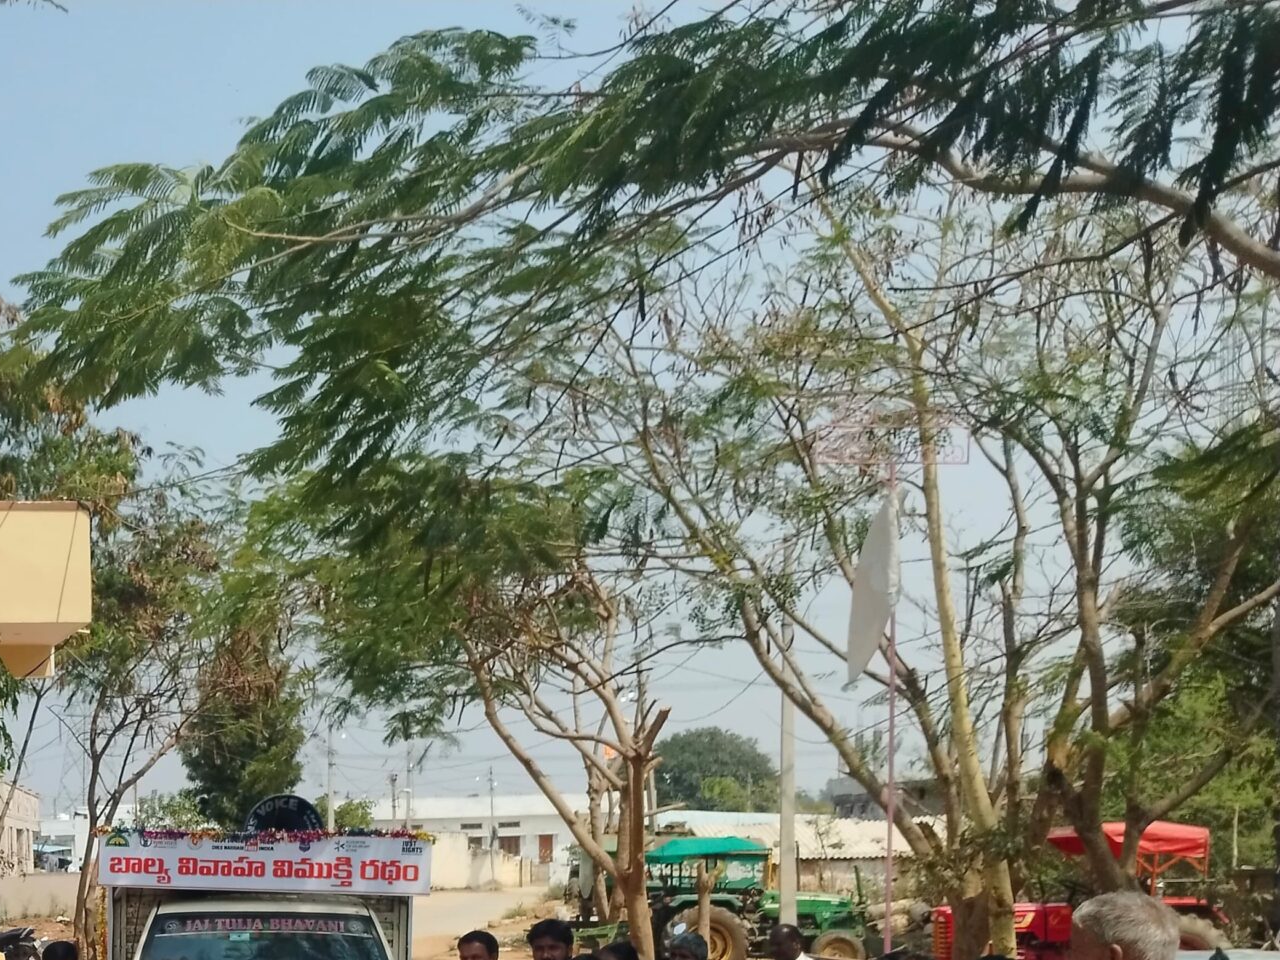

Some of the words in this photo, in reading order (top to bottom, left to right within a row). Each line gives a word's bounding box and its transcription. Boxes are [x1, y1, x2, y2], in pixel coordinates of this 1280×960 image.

[256, 798, 298, 816] VOICE
[109, 856, 172, 884] బాల్య
[178, 856, 266, 878] వివాహ
[272, 856, 352, 888] విముక్తి
[360, 859, 420, 885] రథం
[270, 918, 345, 932] BHAVANI
